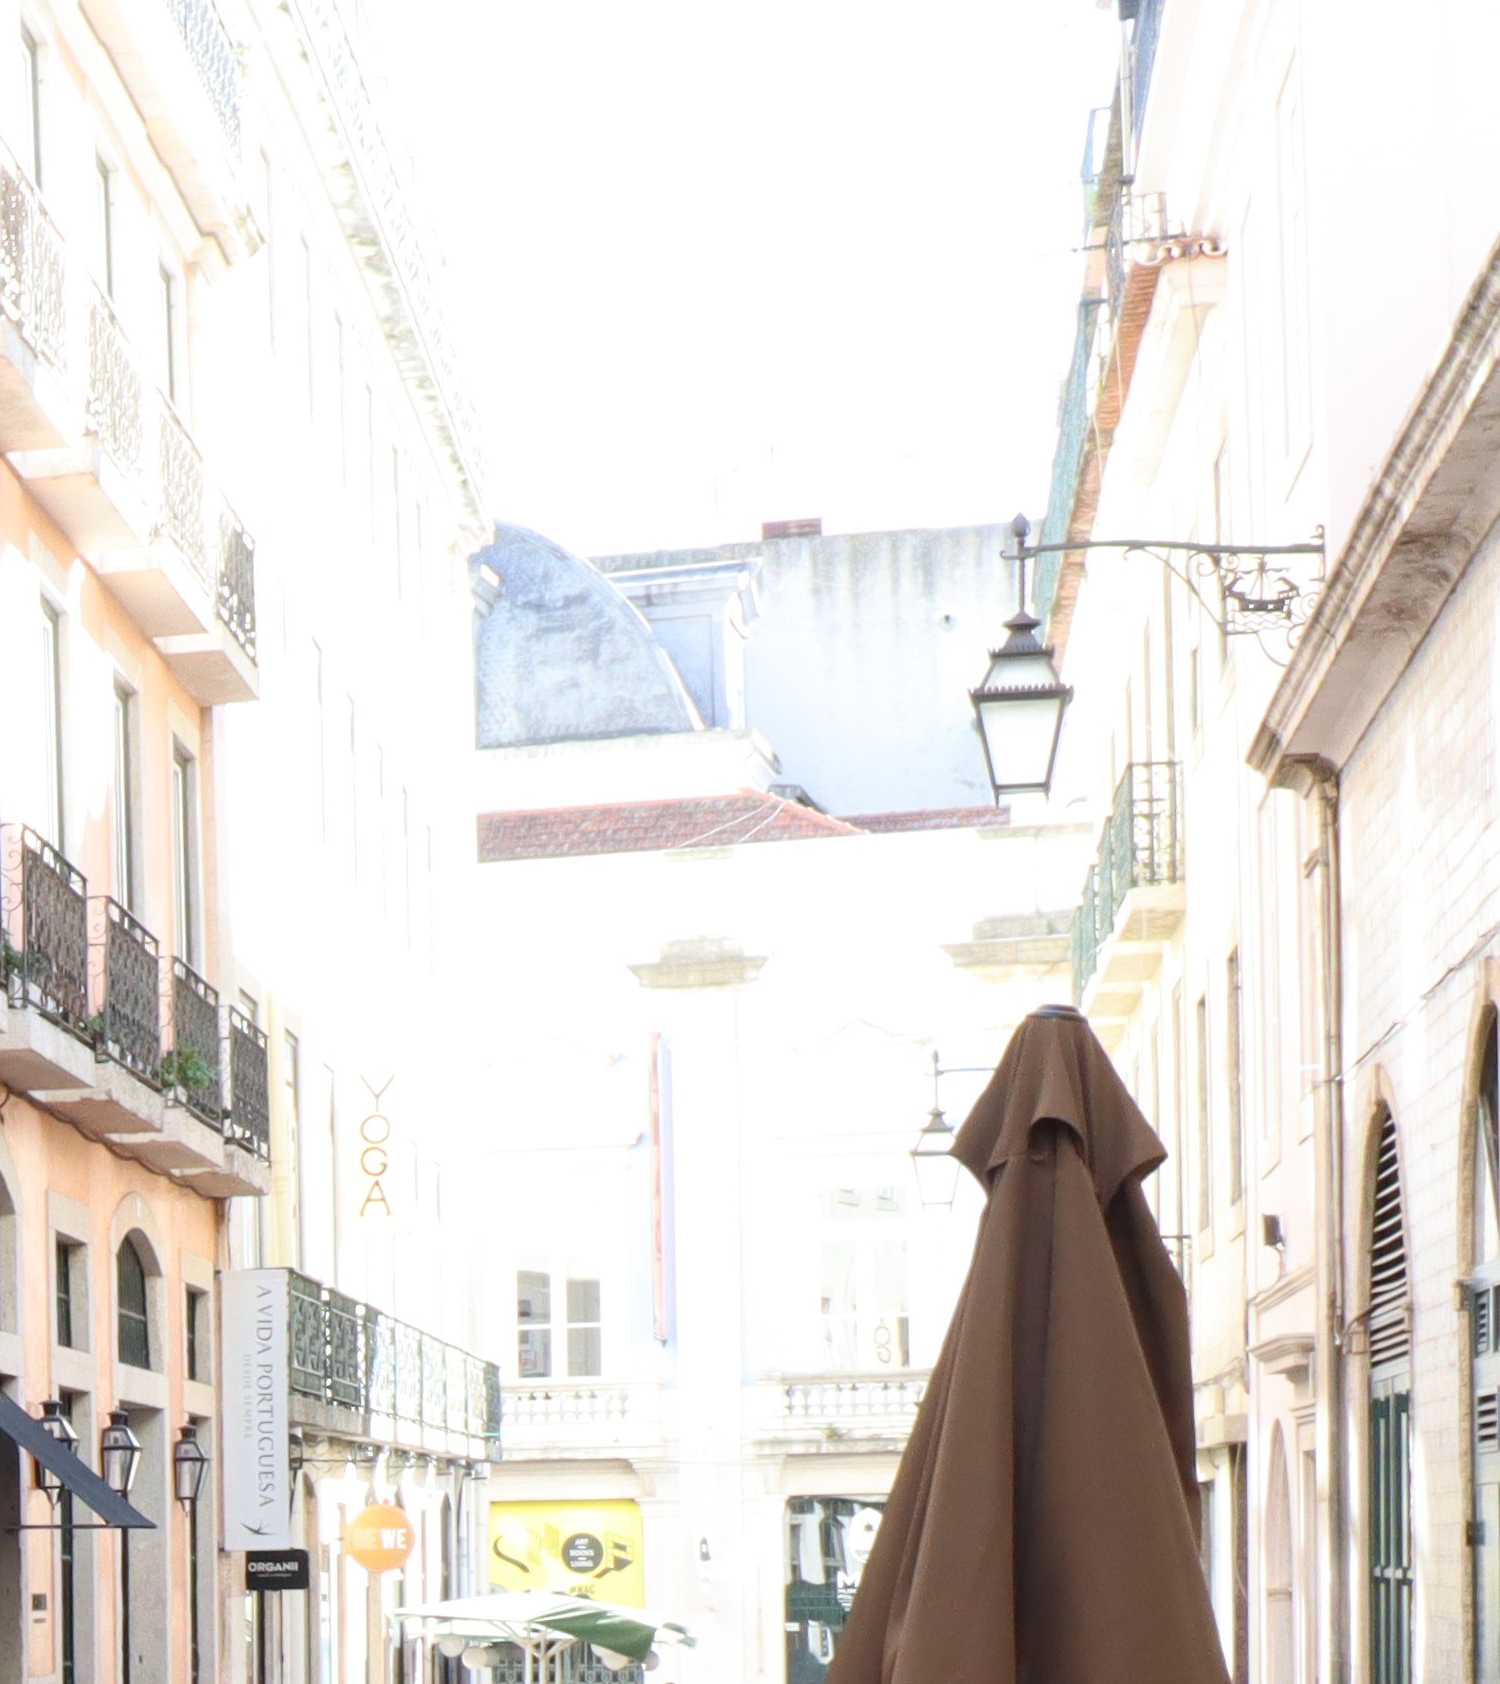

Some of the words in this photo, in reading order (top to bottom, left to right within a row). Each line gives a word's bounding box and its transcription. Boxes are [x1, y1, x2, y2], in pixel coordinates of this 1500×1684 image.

[360, 1073, 395, 1217] YOGA
[256, 1285, 271, 1298] A
[256, 1305, 273, 1355] VIDA
[256, 1363, 275, 1508] PORTUGUESA
